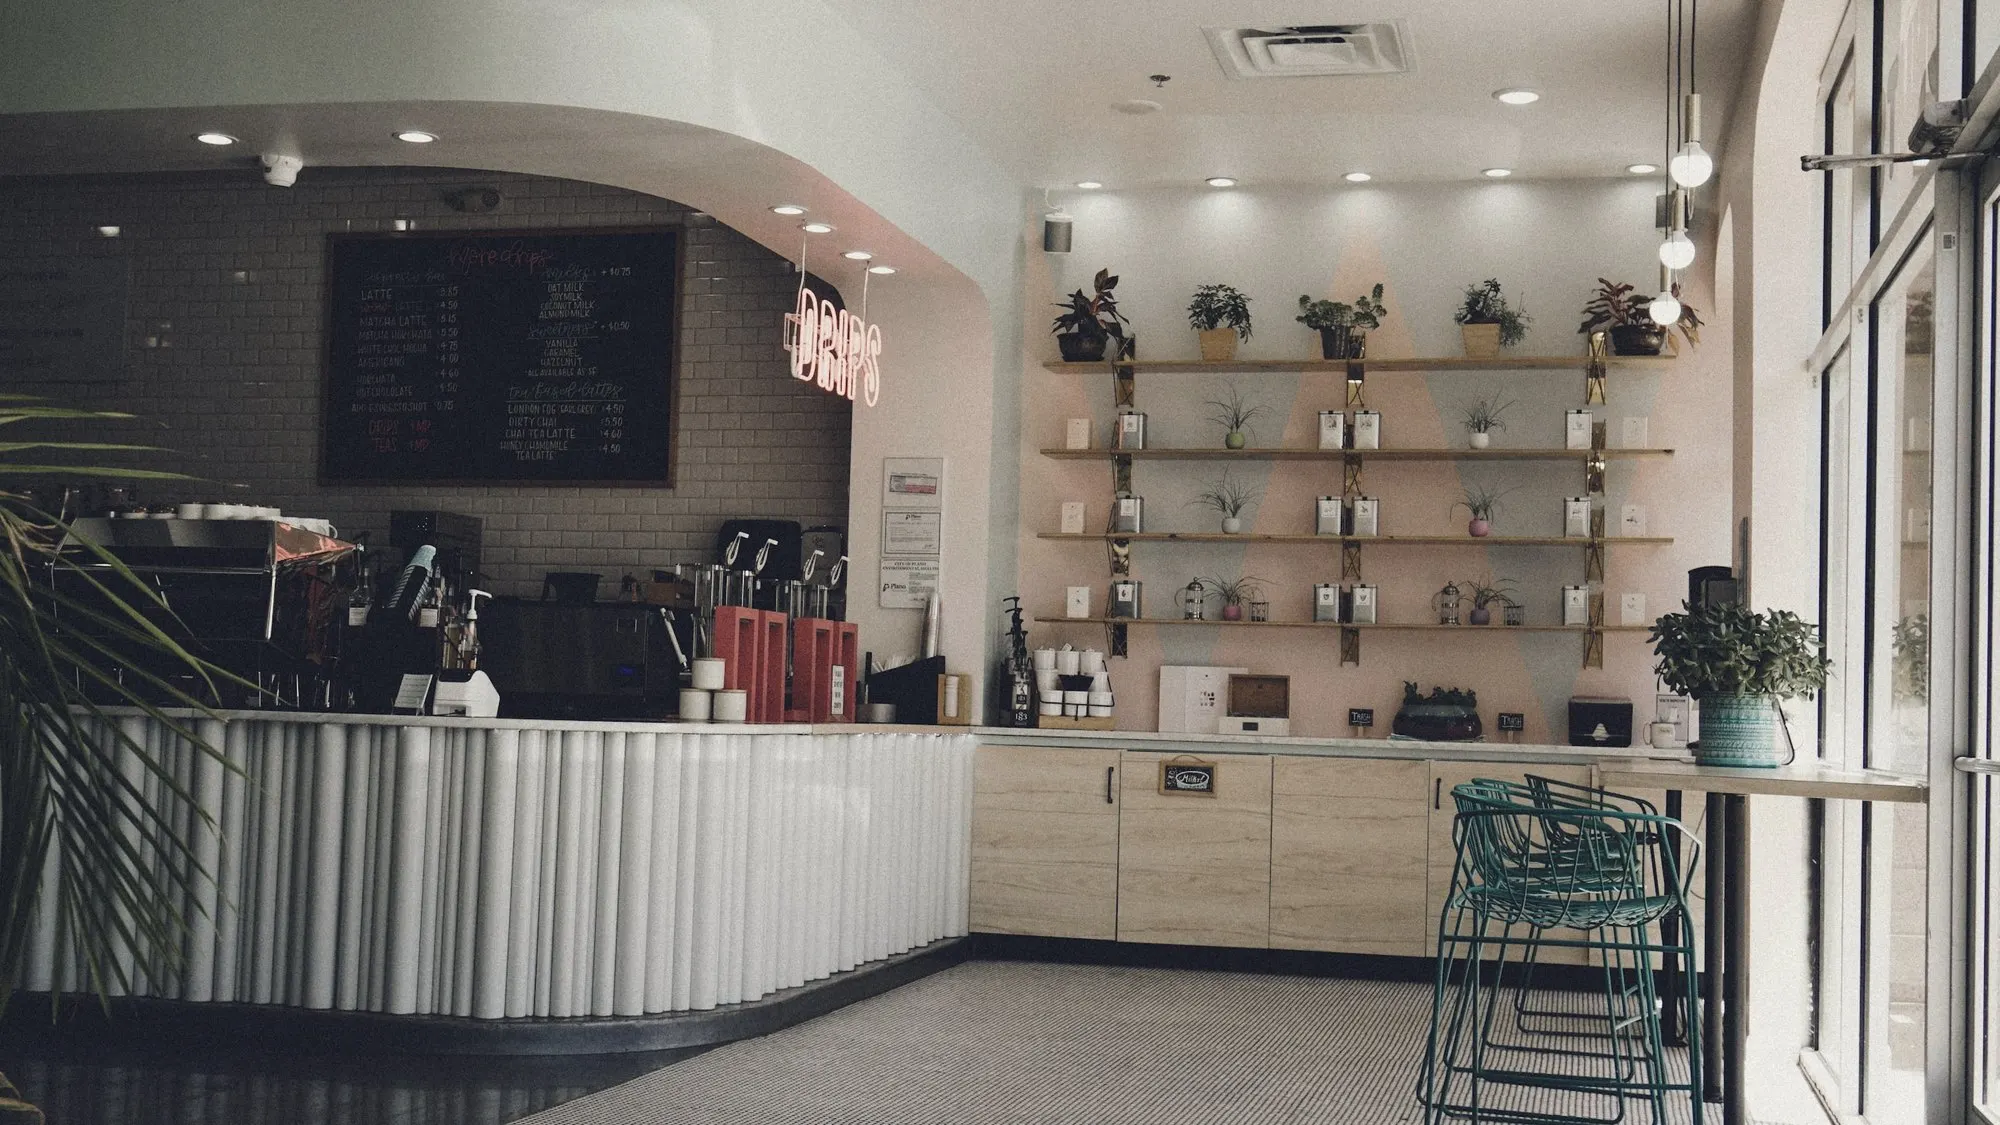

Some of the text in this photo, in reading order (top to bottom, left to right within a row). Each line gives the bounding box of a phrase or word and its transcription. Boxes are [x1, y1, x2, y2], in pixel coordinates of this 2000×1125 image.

[547, 282, 585, 293] OAT MILK
[361, 288, 393, 301] LATTE
[360, 316, 396, 327] MATCHA
[400, 315, 427, 327] LATTE
[545, 339, 579, 348] VANILLA
[791, 288, 882, 407] DRIPS
[544, 348, 580, 358] CARAMEL
[358, 356, 405, 368] AMERICANO
[540, 356, 583, 367] HAZELNUT
[540, 368, 574, 377] AVAILABLE
[508, 404, 540, 414] LONDON
[542, 404, 556, 415] FOG
[508, 416, 535, 427] DIRTY
[537, 416, 558, 428] CHAI
[505, 428, 526, 439] CHAI
[528, 429, 545, 439] TEA
[547, 428, 577, 439] LATTE
[516, 450, 555, 460] TEA LATTE
[1351, 711, 1372, 722] TRASH
